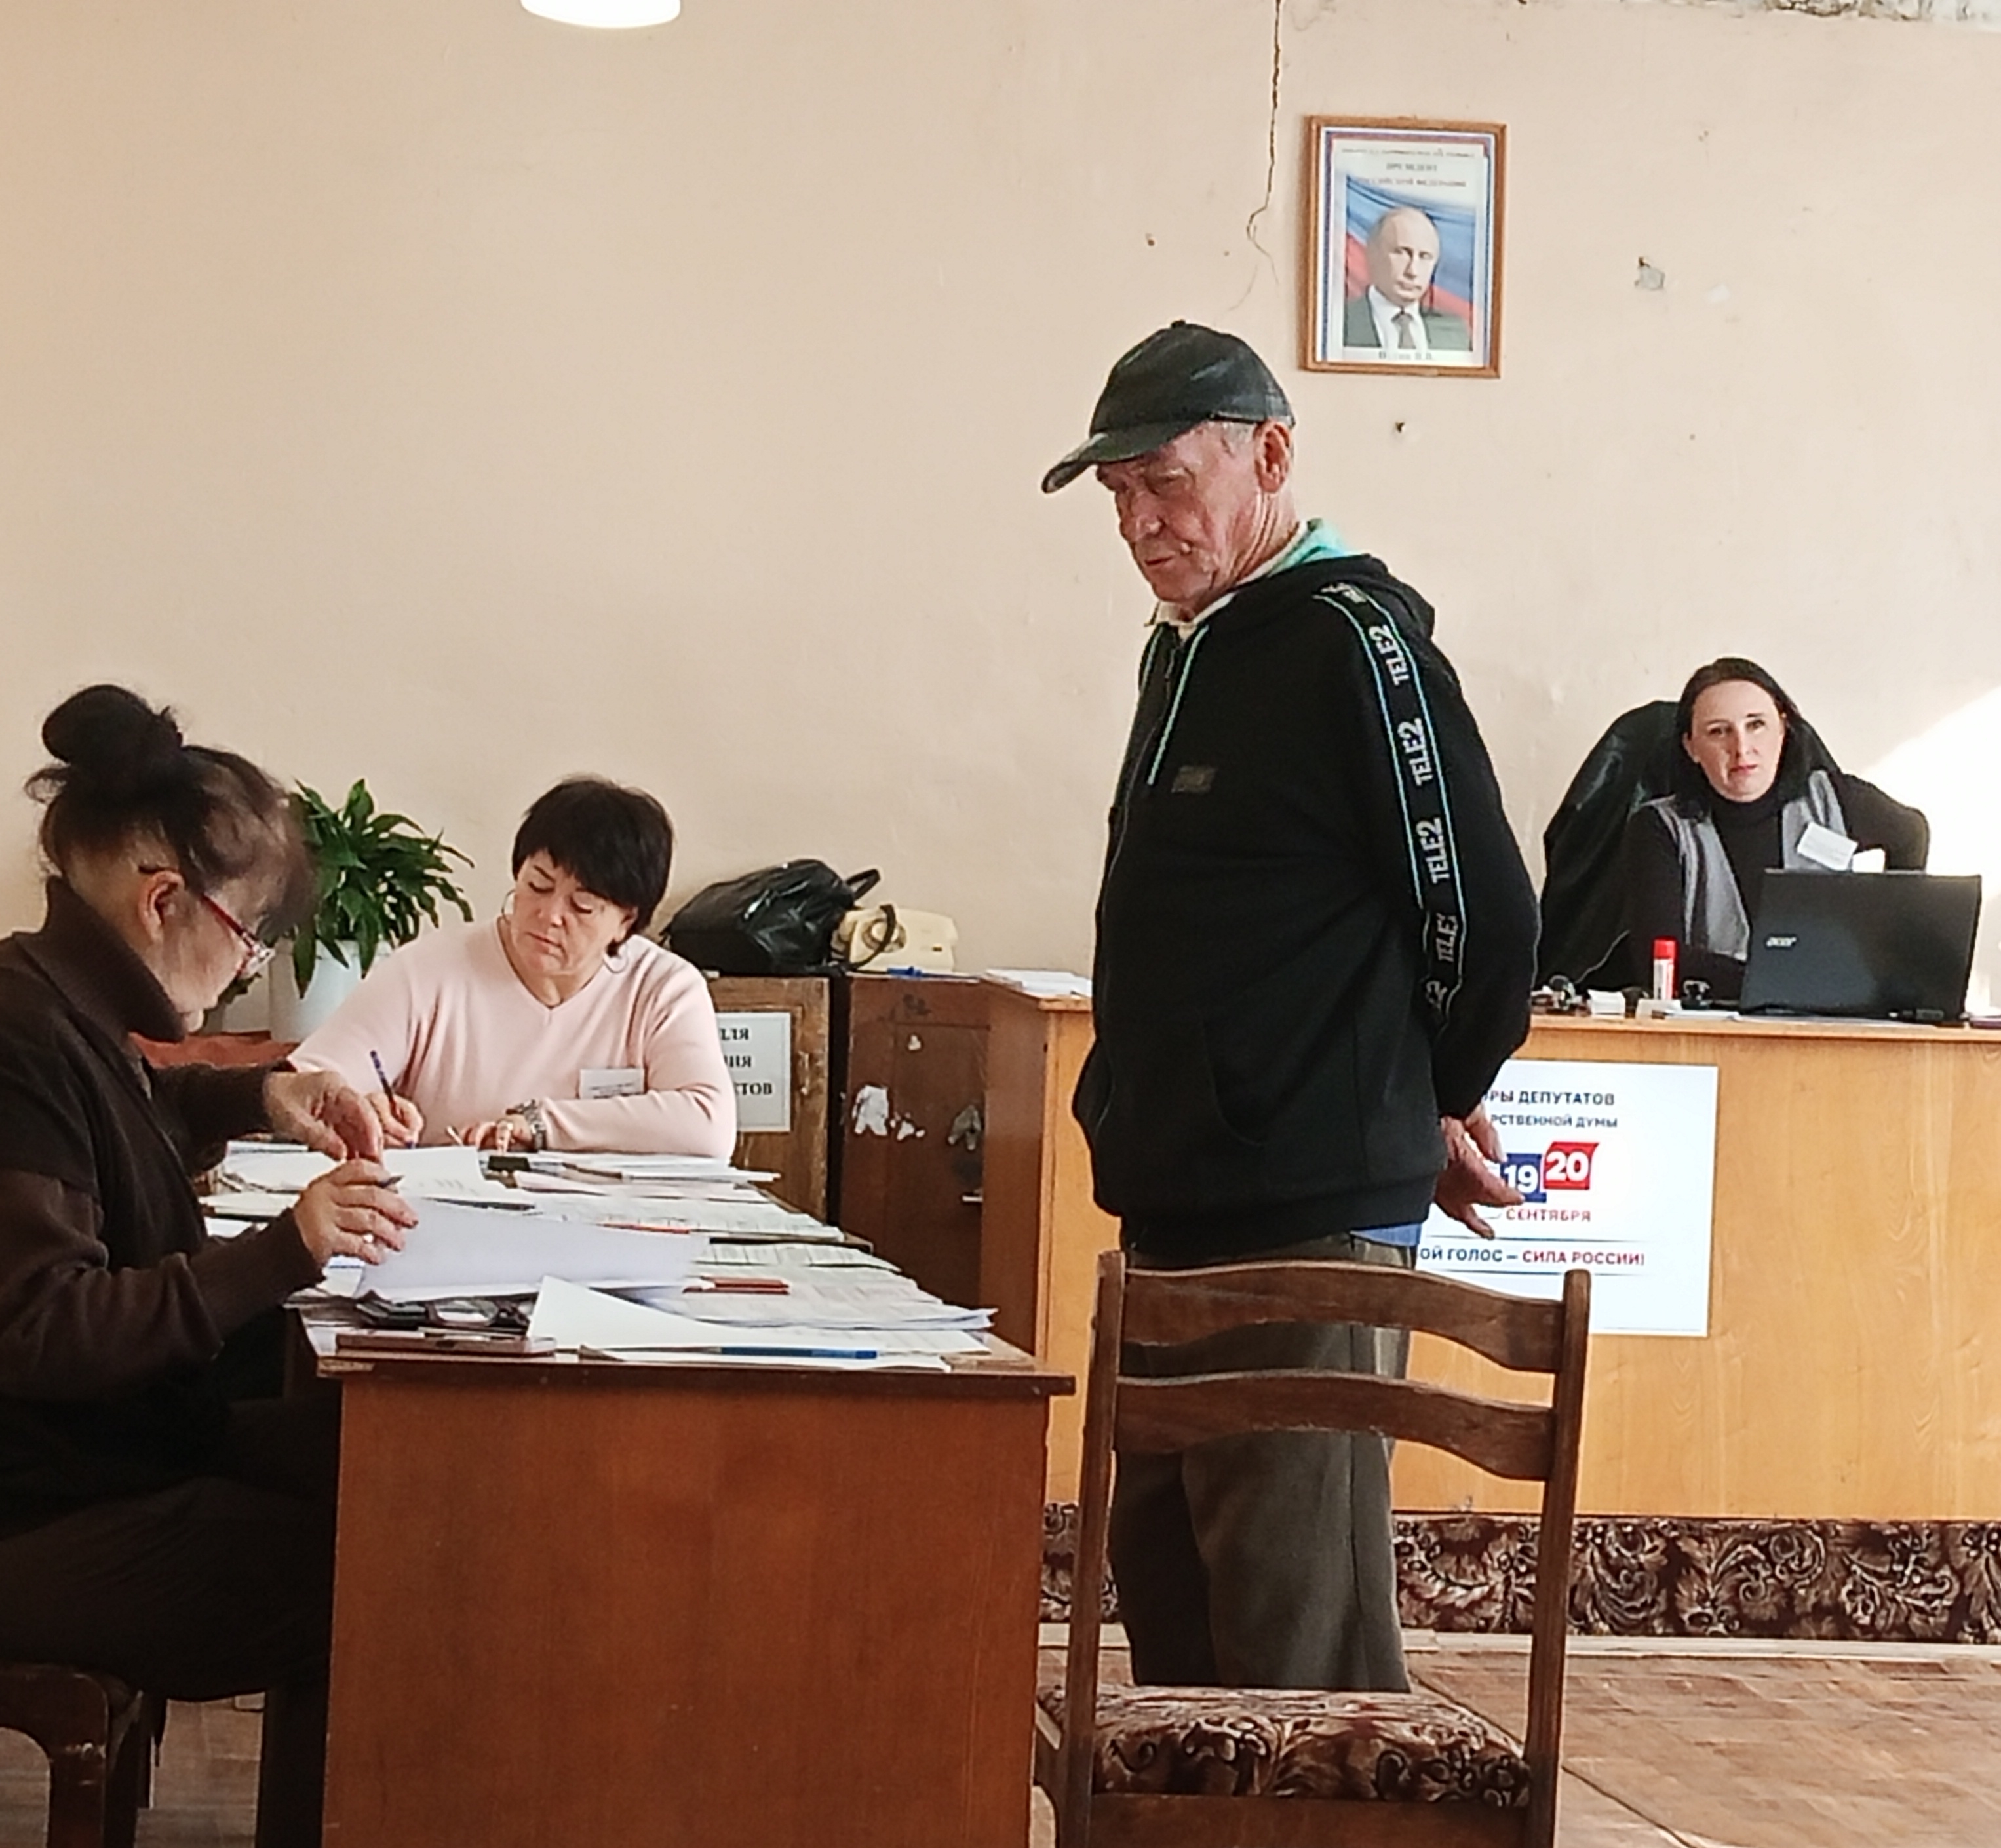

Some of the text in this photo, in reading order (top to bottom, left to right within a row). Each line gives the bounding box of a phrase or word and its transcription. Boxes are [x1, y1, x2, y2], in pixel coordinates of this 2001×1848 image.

[1369, 624, 1410, 686] TELE2
[1397, 718, 1433, 786] TELE2
[1416, 817, 1450, 884] TELE2
[724, 1054, 752, 1069] ИЯ
[735, 1082, 773, 1095] ТОВ
[1518, 1090, 1614, 1105] ДЕПУТАТОВ
[1490, 1113, 1618, 1128] РСТВЕННОЙ ДУМЫ
[1504, 1150, 1589, 1194] 19 20
[1506, 1208, 1591, 1222] СЕНТЯБРЯ
[1419, 1245, 1443, 1261] ОЙ
[1447, 1248, 1503, 1263] ГОЛОС
[1522, 1249, 1566, 1264] СИЛА
[1572, 1251, 1644, 1266] РОССИИ!
